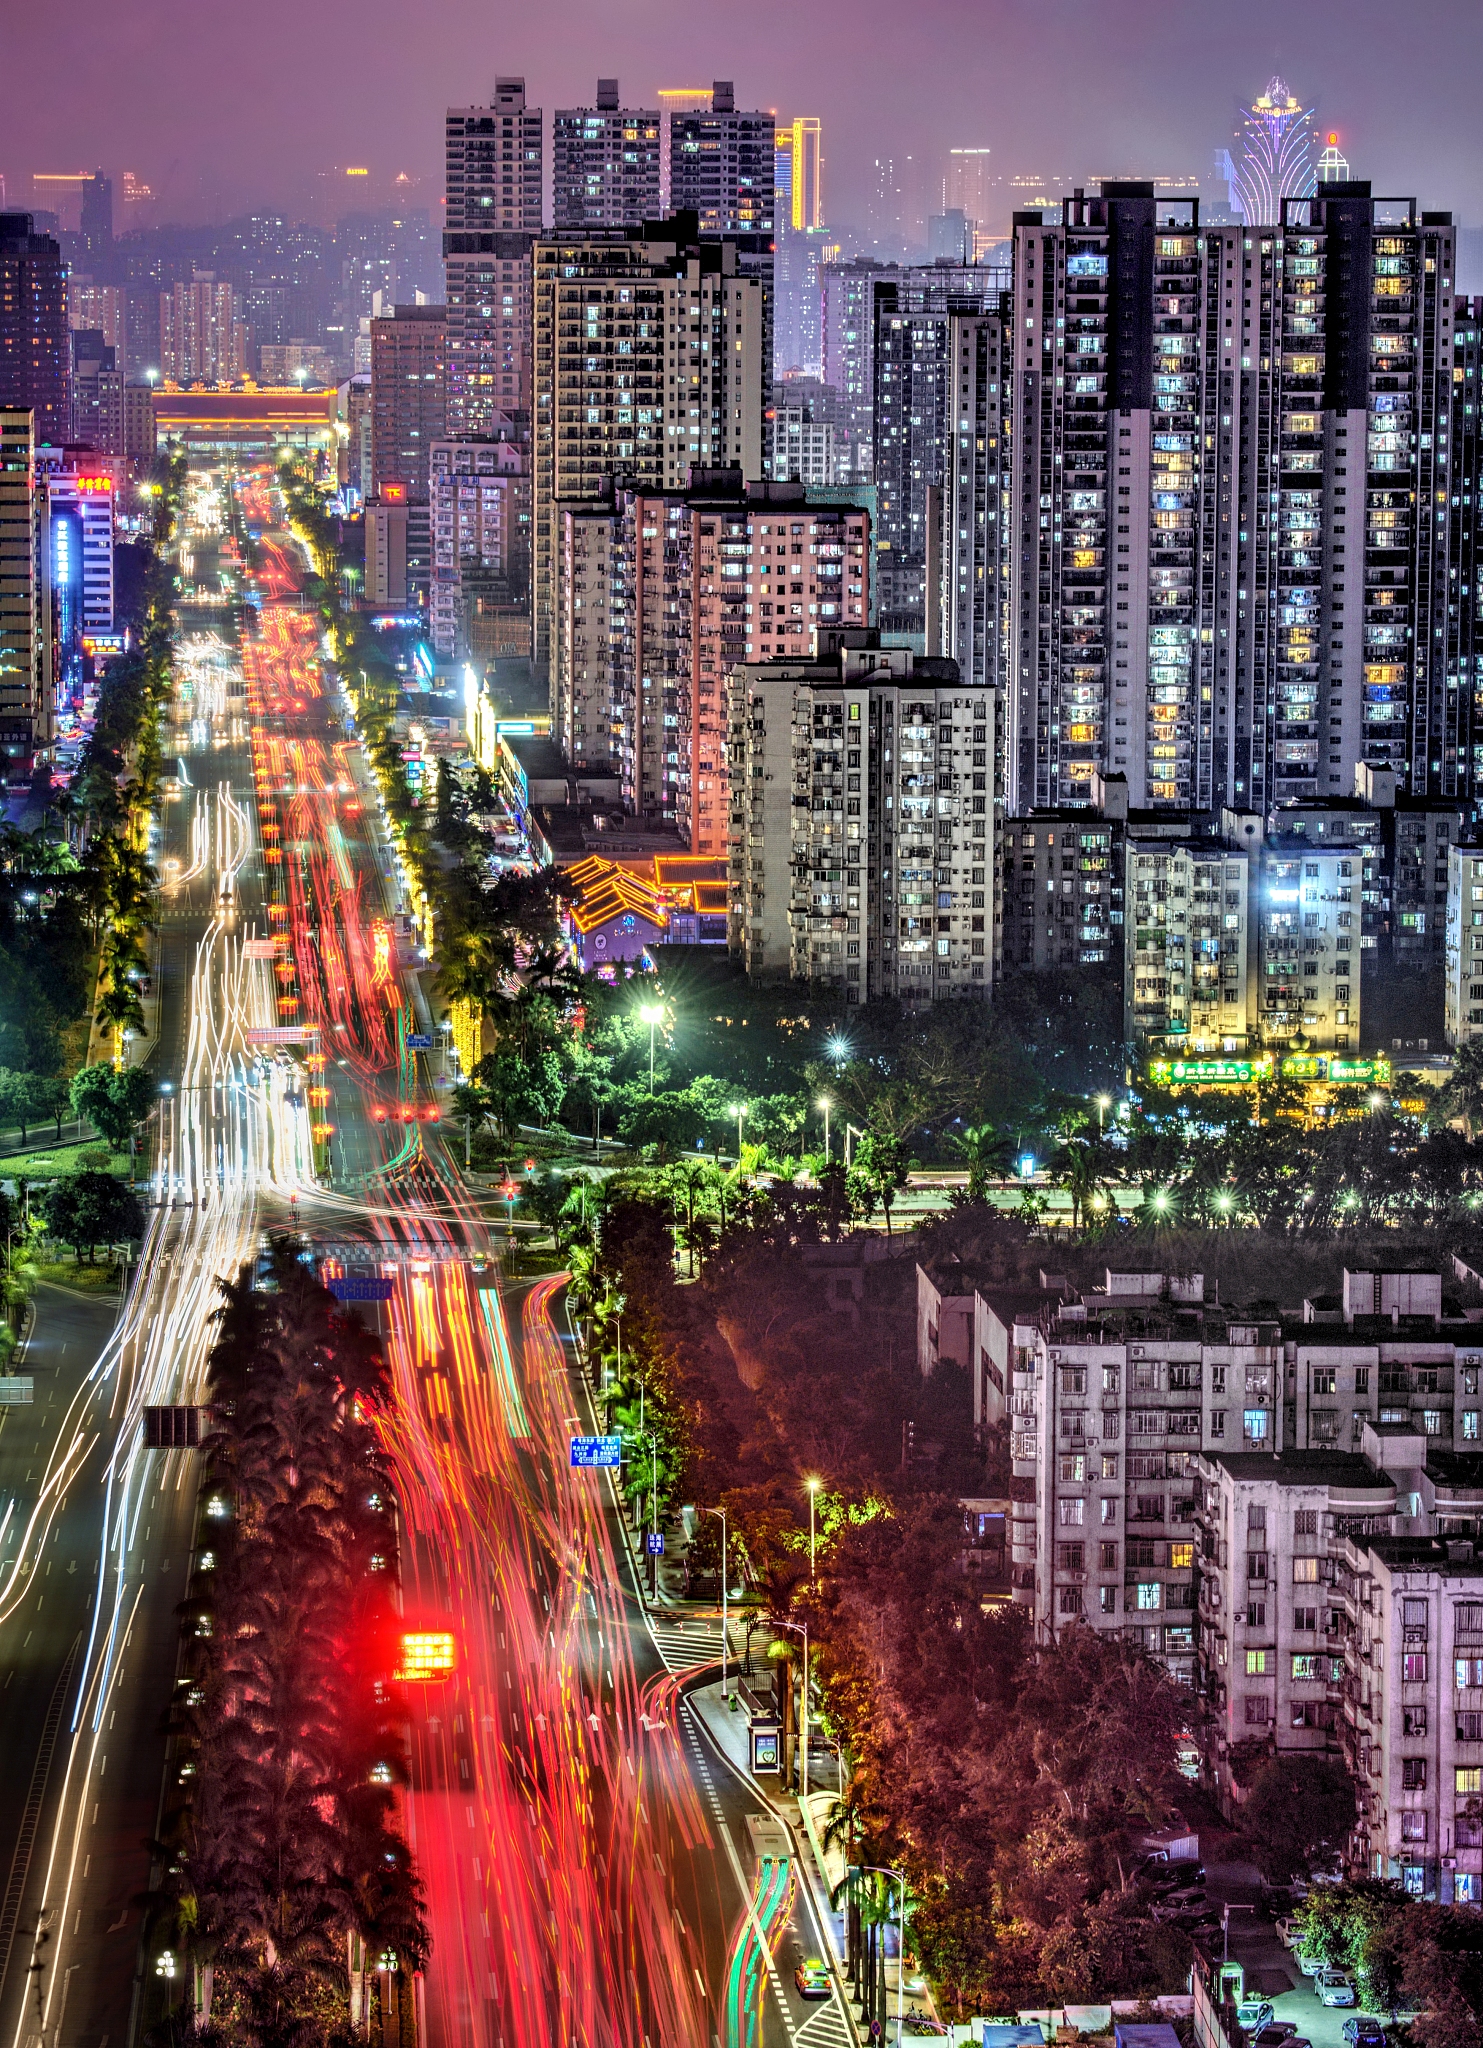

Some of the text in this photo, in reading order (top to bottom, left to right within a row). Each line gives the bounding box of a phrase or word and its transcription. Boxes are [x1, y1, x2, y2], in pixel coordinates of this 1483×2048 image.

[1251, 105, 1303, 116] GRAND LISBOA
[164, 379, 259, 394] 拱北口岸
